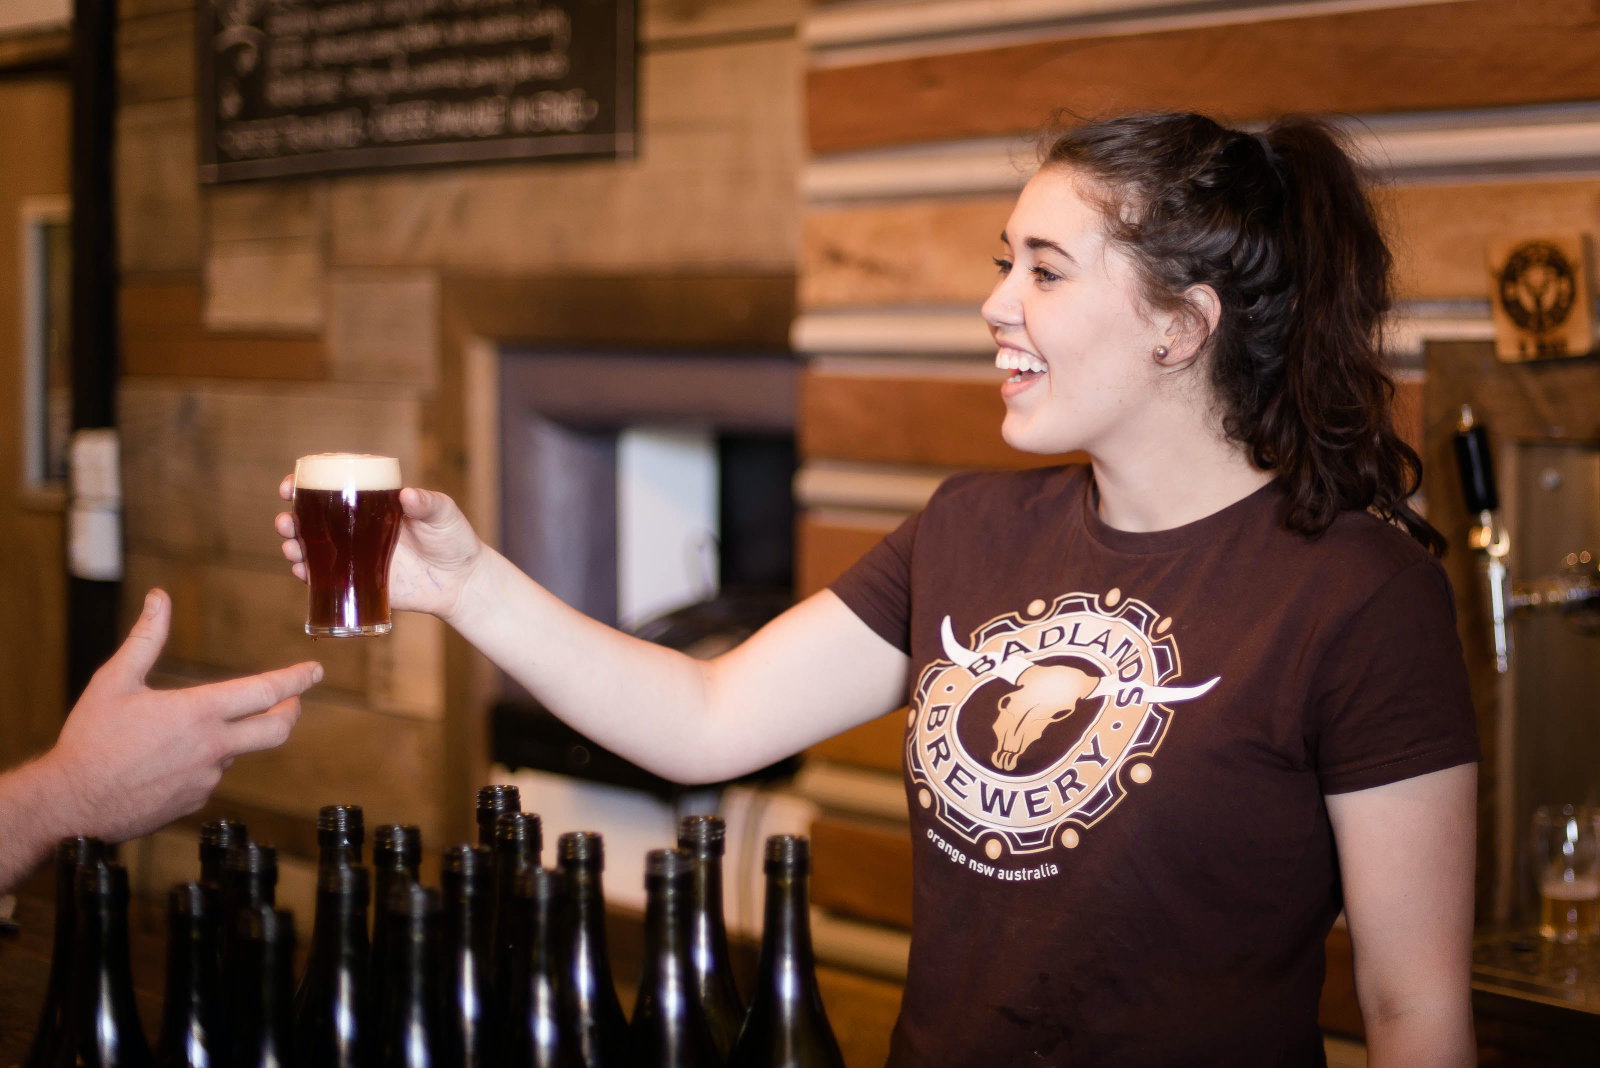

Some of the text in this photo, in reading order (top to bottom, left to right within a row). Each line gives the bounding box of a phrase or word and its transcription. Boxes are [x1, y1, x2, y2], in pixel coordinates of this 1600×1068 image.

[966, 621, 1145, 709] BADLANDS
[926, 704, 1111, 819] BREWERY
[927, 828, 1059, 881] orange nsw australia
